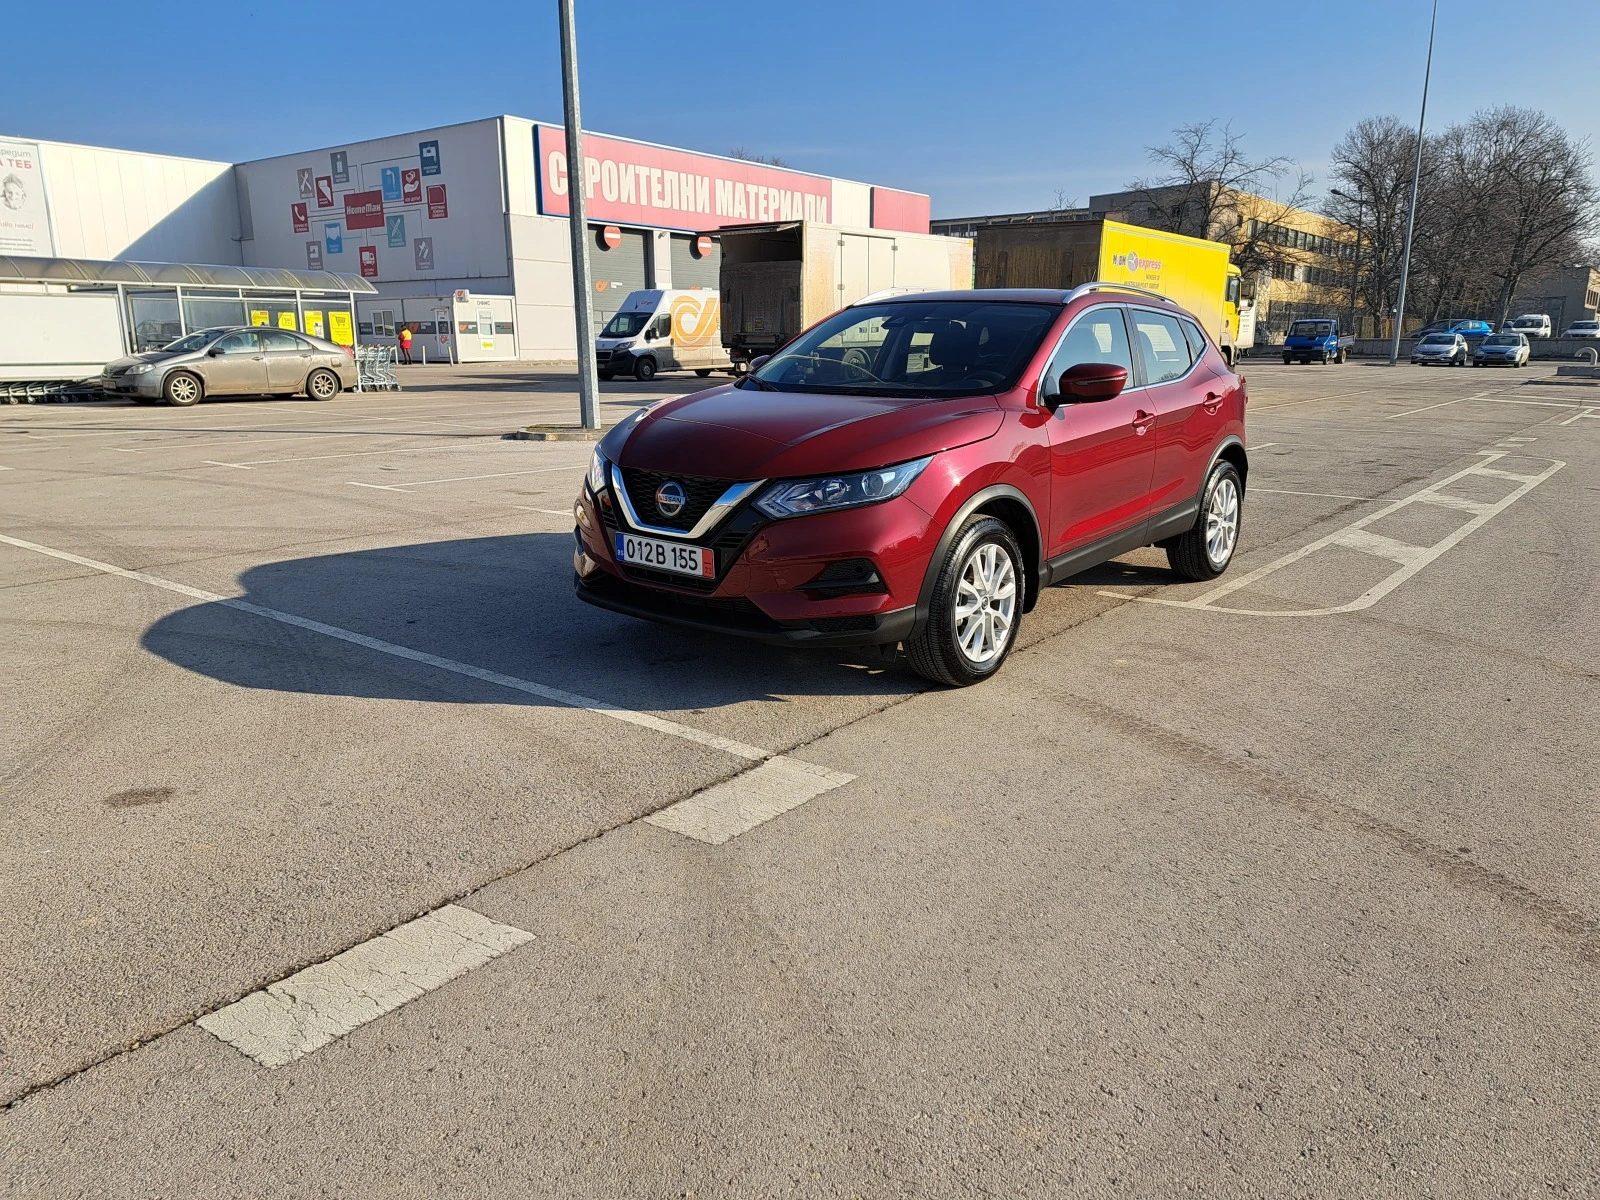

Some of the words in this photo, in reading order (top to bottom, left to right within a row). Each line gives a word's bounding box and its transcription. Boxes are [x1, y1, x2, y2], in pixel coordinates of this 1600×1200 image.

[6, 158, 32, 169] ТЕБ
[548, 151, 710, 214] СРОИТЕЛНИ
[715, 178, 828, 223] МАТЕРИАЛИ
[346, 203, 381, 215] HomeMax
[1139, 258, 1161, 271] express
[626, 539, 666, 565] 012B
[671, 546, 698, 571] 155
